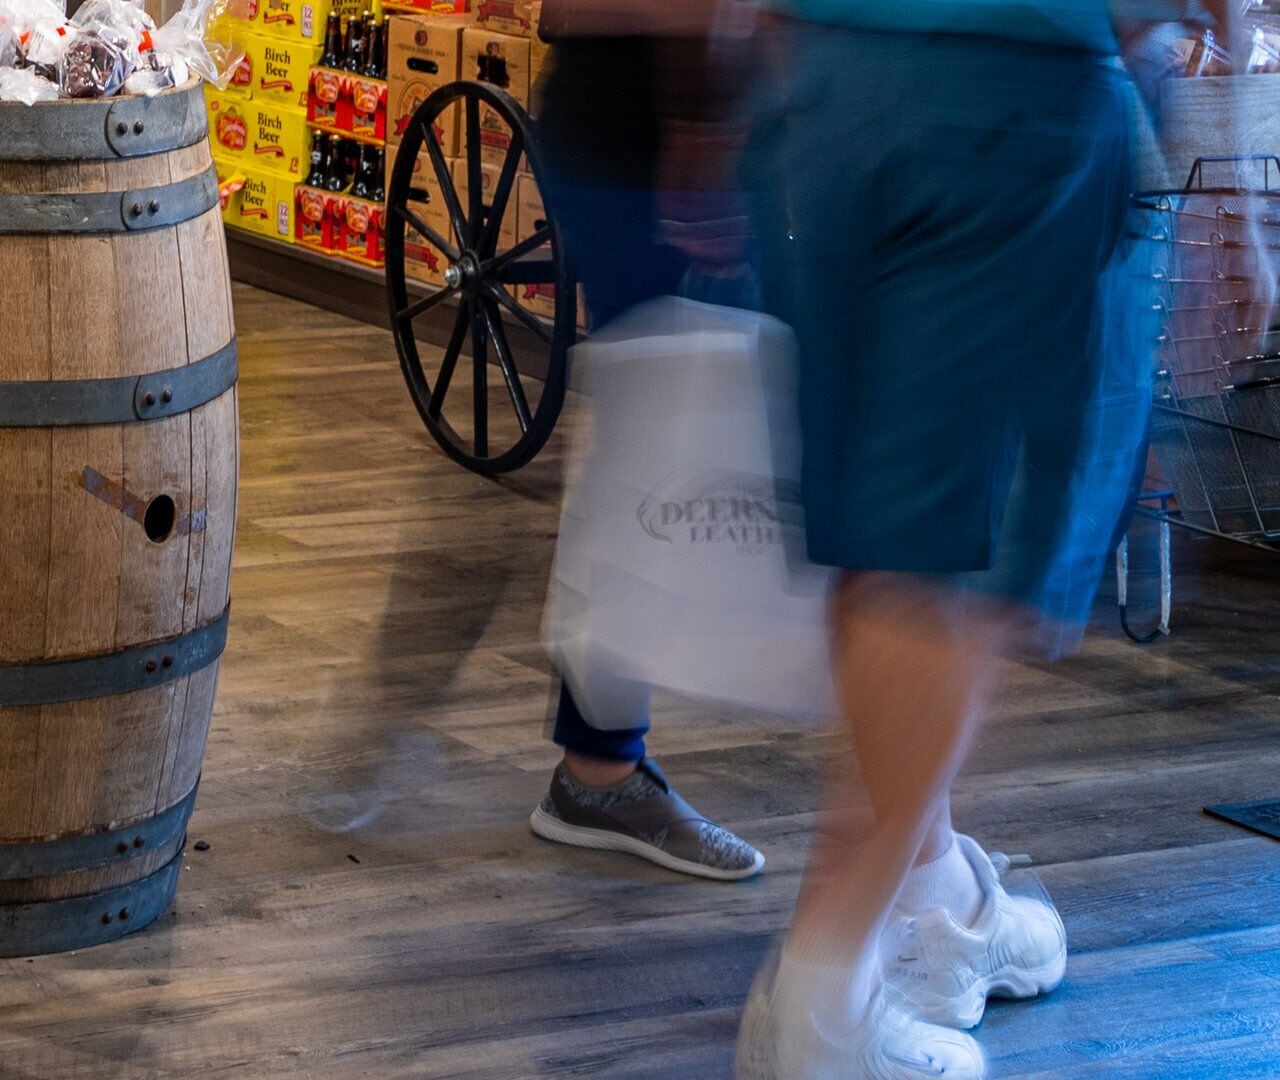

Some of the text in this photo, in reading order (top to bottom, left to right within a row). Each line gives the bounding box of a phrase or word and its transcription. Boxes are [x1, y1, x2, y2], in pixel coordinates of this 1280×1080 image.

[303, 6, 312, 20] 12
[264, 46, 291, 65] Birch
[265, 62, 289, 80] Beer
[257, 111, 283, 131] Birch
[258, 127, 281, 144] Beer
[244, 178, 267, 194] Birch
[244, 192, 265, 207] Beer
[278, 202, 289, 217] 12
